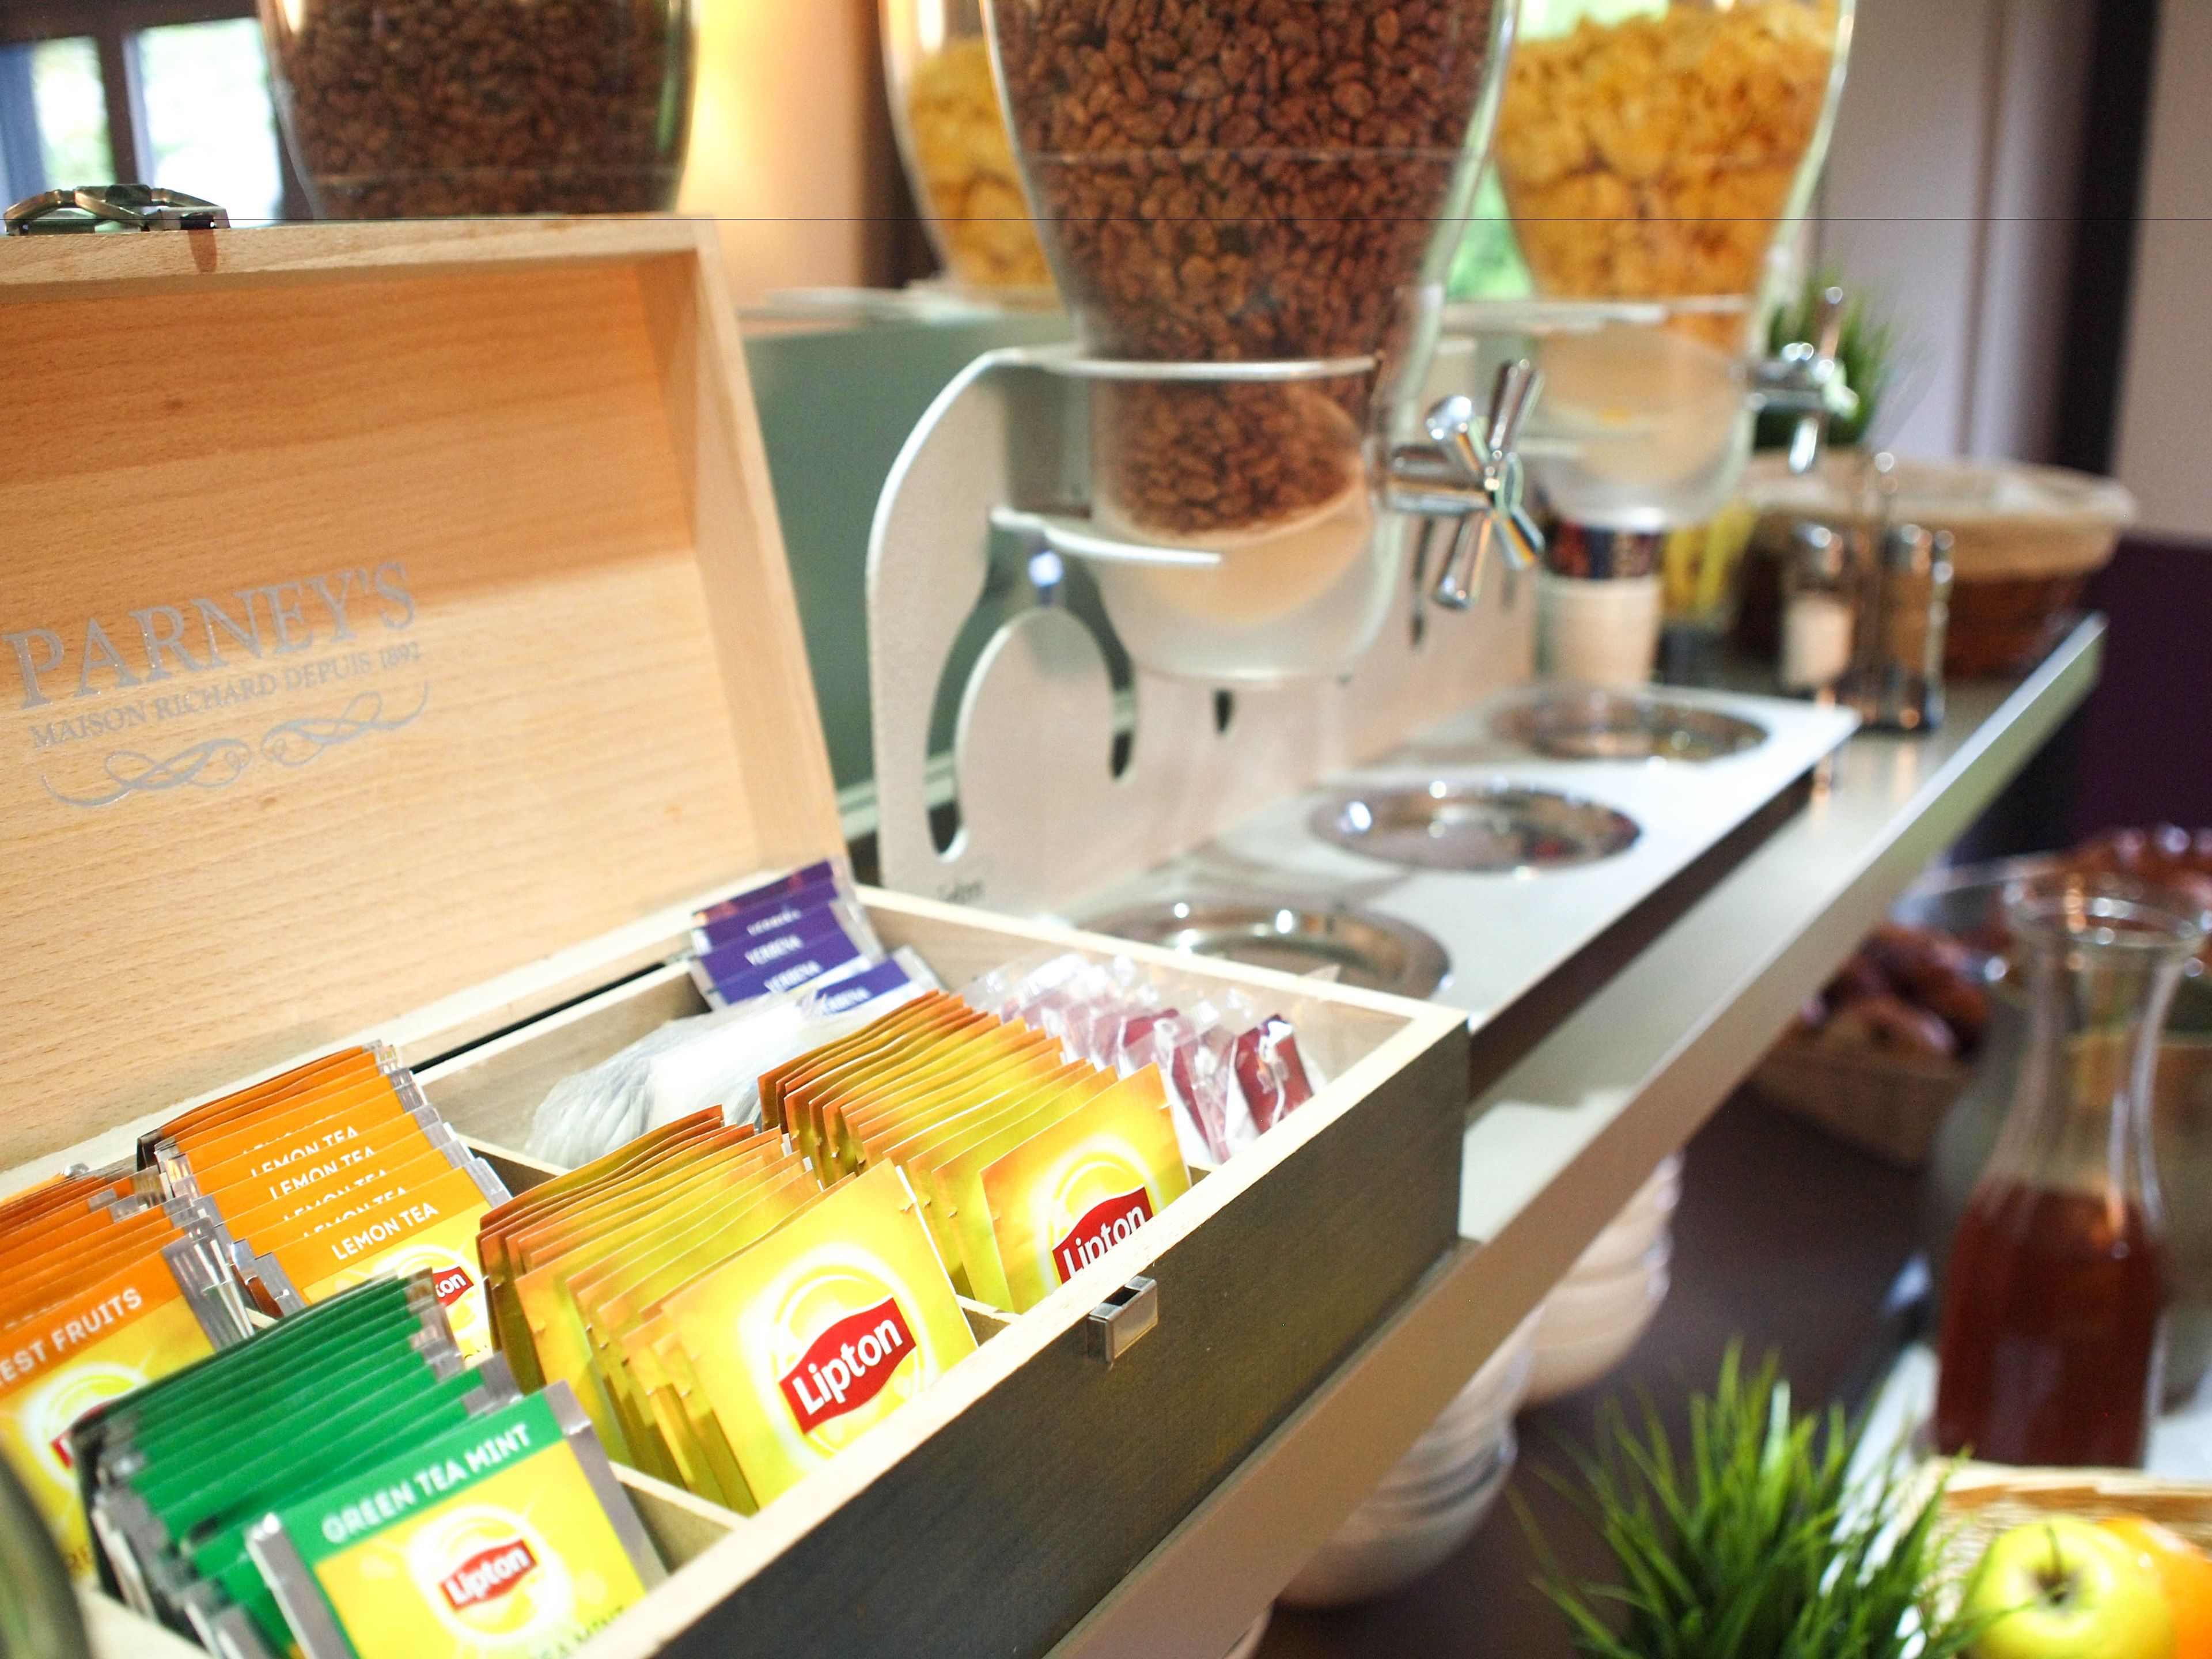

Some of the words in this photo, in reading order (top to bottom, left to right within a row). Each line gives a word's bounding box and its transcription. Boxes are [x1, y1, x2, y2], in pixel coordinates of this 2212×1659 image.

[4, 561, 415, 710] PARNEY'S
[28, 700, 147, 749] MAISON
[153, 673, 278, 721] RICHARD
[282, 652, 371, 690] DEPUIS
[269, 1161, 338, 1200] LEMON
[340, 1146, 376, 1166] TEA
[331, 1217, 402, 1260] LEMON
[399, 1202, 440, 1228] TEA
[0, 1339, 47, 1383] EST
[51, 1287, 142, 1352] FRUITS
[791, 1318, 903, 1416] Lipton
[322, 1479, 416, 1544] GREEN
[413, 1458, 468, 1497] TEA
[464, 1422, 532, 1473] MINT
[444, 1547, 531, 1604] Lipton
